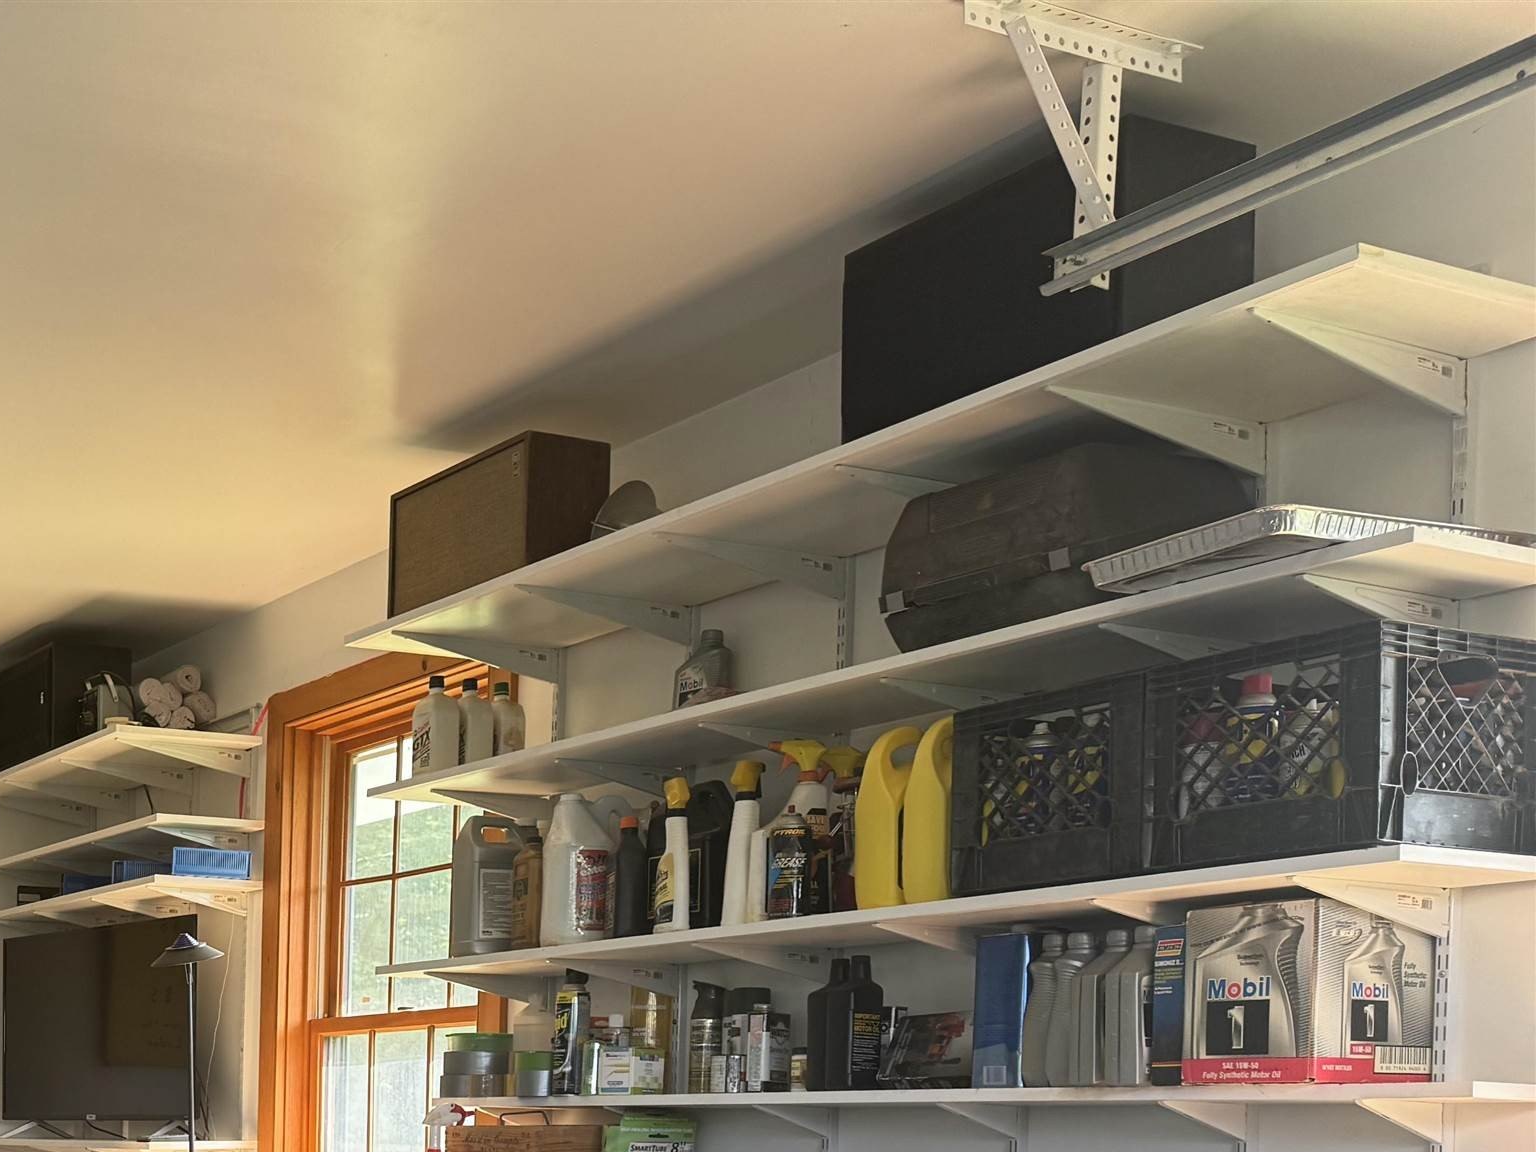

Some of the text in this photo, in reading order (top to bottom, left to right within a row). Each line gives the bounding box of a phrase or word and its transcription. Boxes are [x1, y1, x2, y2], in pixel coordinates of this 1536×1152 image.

[412, 727, 431, 750] GTX
[1207, 976, 1271, 999] Mobil
[1352, 983, 1389, 999] Mobil
[1227, 1005, 1245, 1049] 1
[1364, 1004, 1375, 1038] 1
